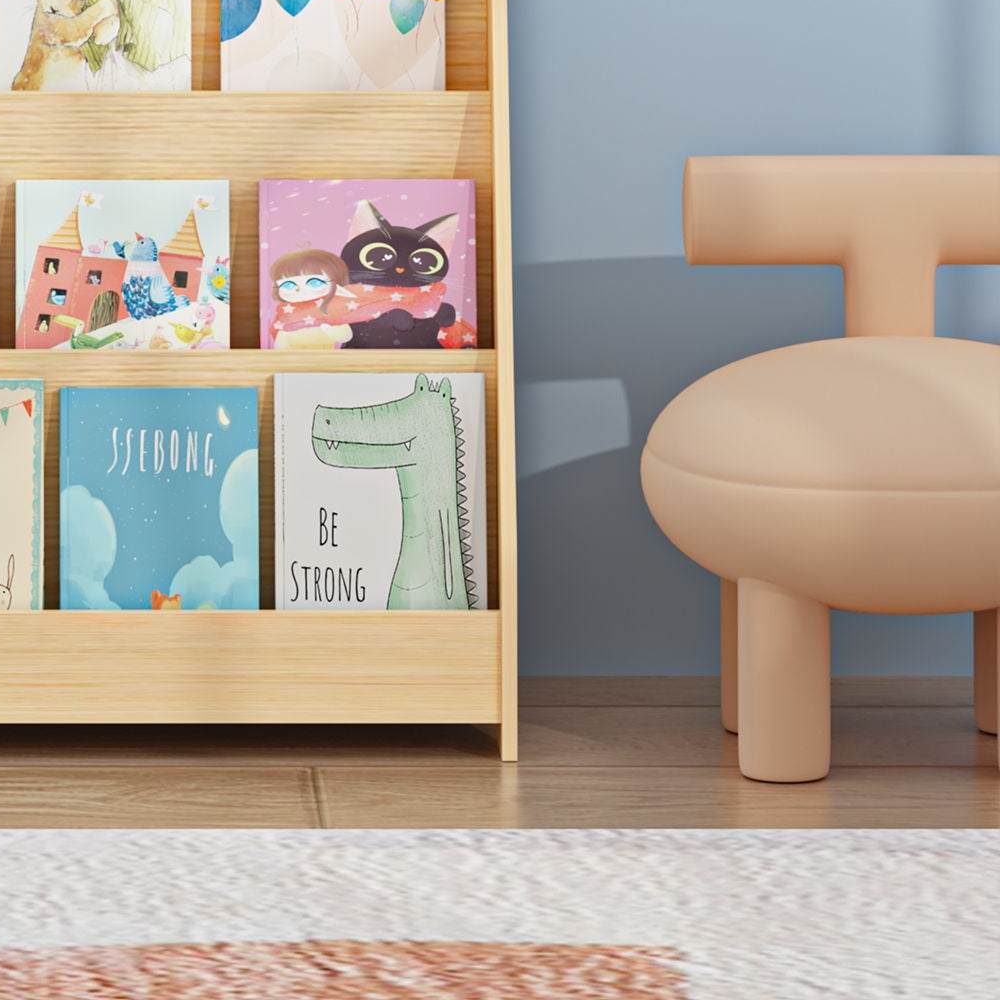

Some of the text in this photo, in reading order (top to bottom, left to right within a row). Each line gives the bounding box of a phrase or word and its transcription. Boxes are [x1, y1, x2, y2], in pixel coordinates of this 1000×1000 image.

[106, 426, 216, 477] SSEBONG
[319, 507, 338, 548] BE
[290, 560, 366, 603] STRONG
